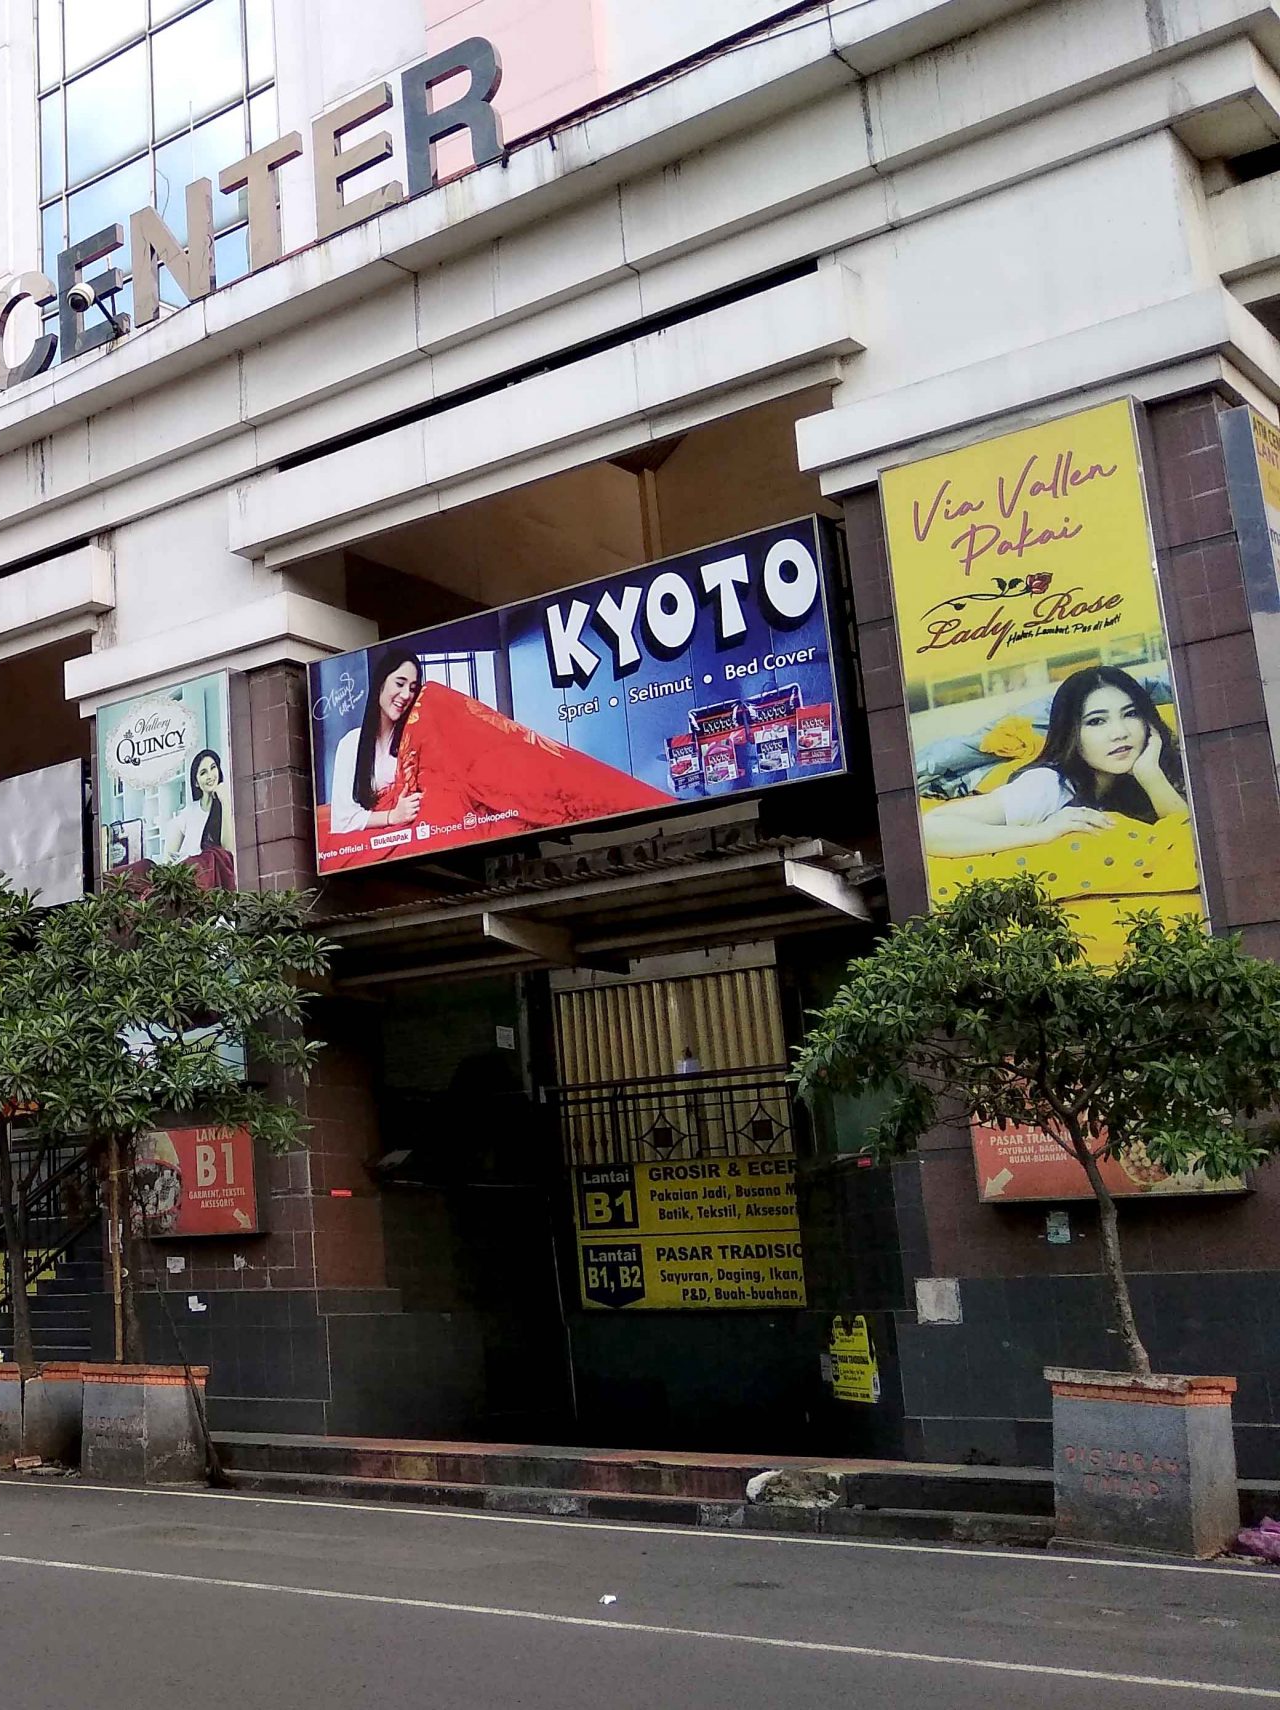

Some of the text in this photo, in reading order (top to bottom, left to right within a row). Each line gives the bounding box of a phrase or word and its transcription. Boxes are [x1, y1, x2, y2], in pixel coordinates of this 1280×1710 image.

[913, 450, 1118, 542] Via Vallen
[950, 510, 1083, 576] Pakai
[546, 538, 818, 684] KYOTO
[916, 587, 1124, 660] Lady Rose
[1072, 622, 1091, 634] Pas
[1093, 619, 1102, 631] di
[558, 647, 816, 722] Sprei Selimut Bed Cover
[477, 809, 519, 825] tokopedia
[430, 823, 462, 837] Shopee
[339, 844, 364, 856] Official
[990, 1134, 1023, 1147] PASAR
[195, 1142, 235, 1187] B1
[648, 1163, 721, 1182] GROSIR
[727, 1162, 741, 1177] &
[582, 1169, 630, 1185] Lantai
[188, 1187, 246, 1200] GARMENT, TEKSTIL
[650, 1188, 699, 1202] Pakaian
[702, 1185, 731, 1201] Jadi,
[735, 1185, 781, 1198] Busana
[200, 1198, 235, 1209] AKSESORIS
[585, 1190, 634, 1224] B1
[658, 1207, 694, 1221] Batik,
[697, 1203, 741, 1220] Tekstil,
[589, 1248, 637, 1263] Lantai
[656, 1245, 713, 1262] PASAR
[587, 1265, 643, 1293] B1, B2
[660, 1266, 803, 1285] Sayuran, Daging, Ikan,
[682, 1286, 803, 1302] P&D, Buah-buahan,
